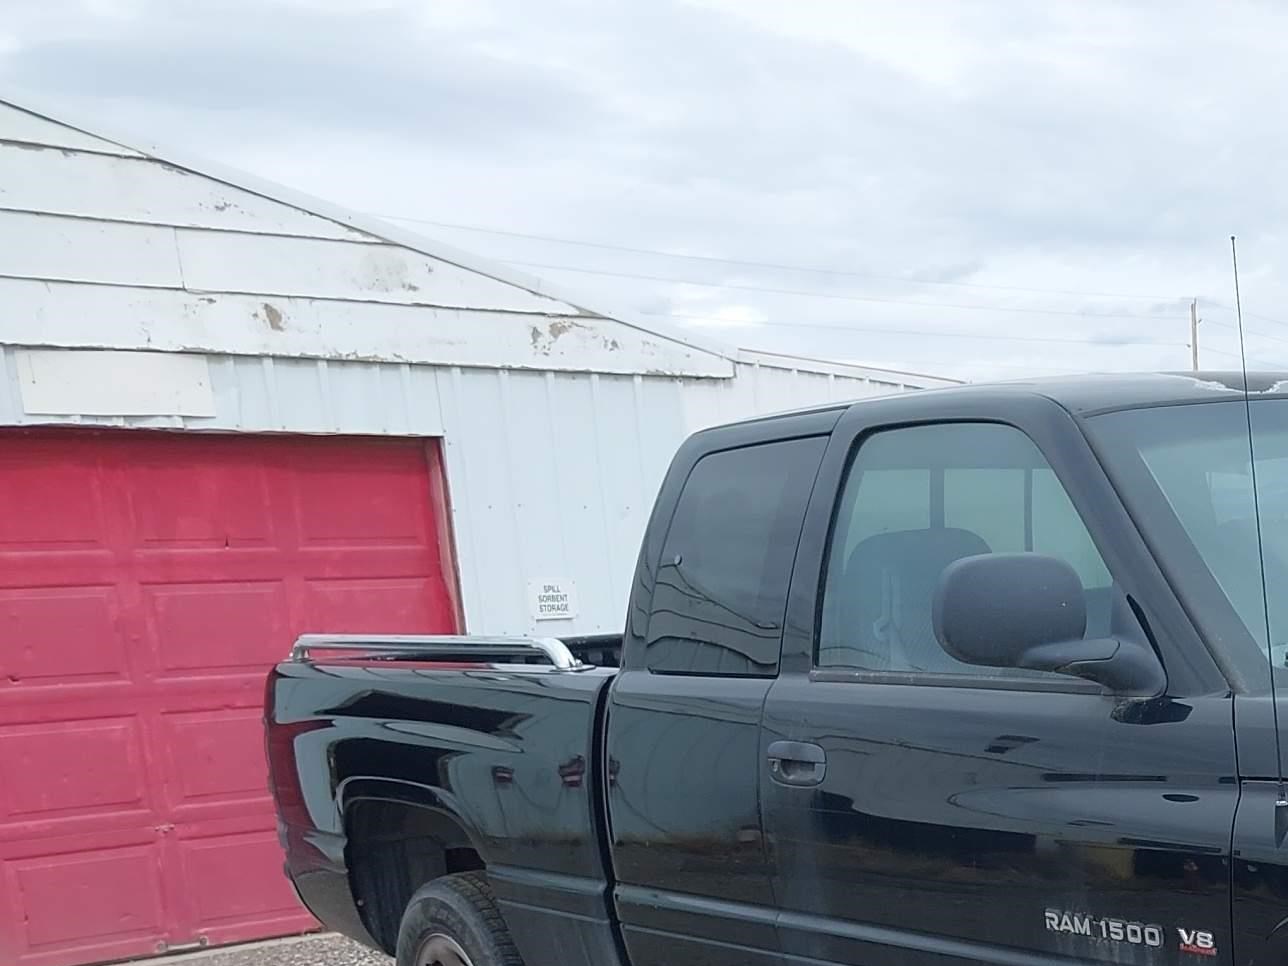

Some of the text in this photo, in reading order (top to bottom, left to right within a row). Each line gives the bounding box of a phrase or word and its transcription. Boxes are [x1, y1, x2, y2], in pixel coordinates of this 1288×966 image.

[543, 584, 561, 593] SPILL
[538, 593, 568, 603] SORBENT
[539, 603, 569, 613] STORAGE
[1044, 911, 1161, 947] RAM 1500
[1176, 927, 1214, 949] V8
